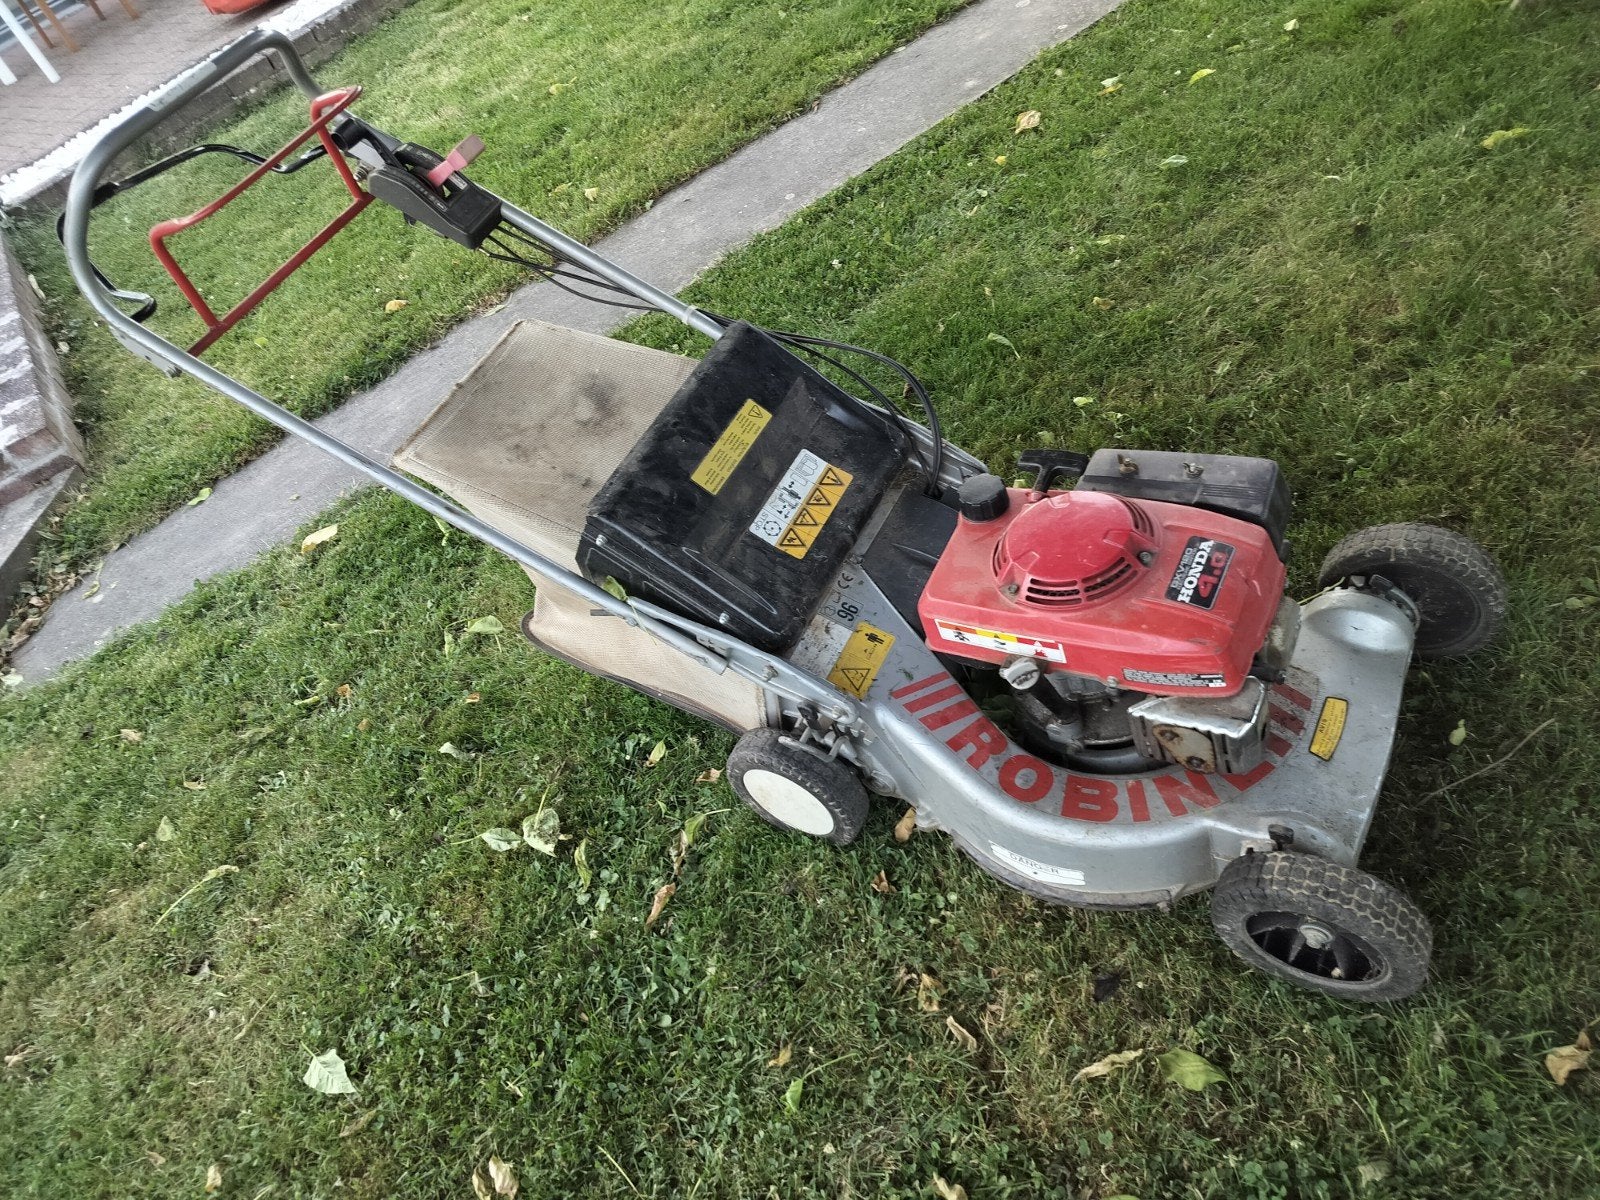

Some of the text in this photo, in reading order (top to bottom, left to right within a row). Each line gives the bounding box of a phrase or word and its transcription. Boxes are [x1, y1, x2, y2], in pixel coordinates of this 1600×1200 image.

[755, 512, 769, 531] STOP
[837, 572, 854, 590] CE
[1177, 540, 1215, 603] HONDA
[837, 601, 859, 622] 96
[1009, 853, 1059, 874] DANGR
